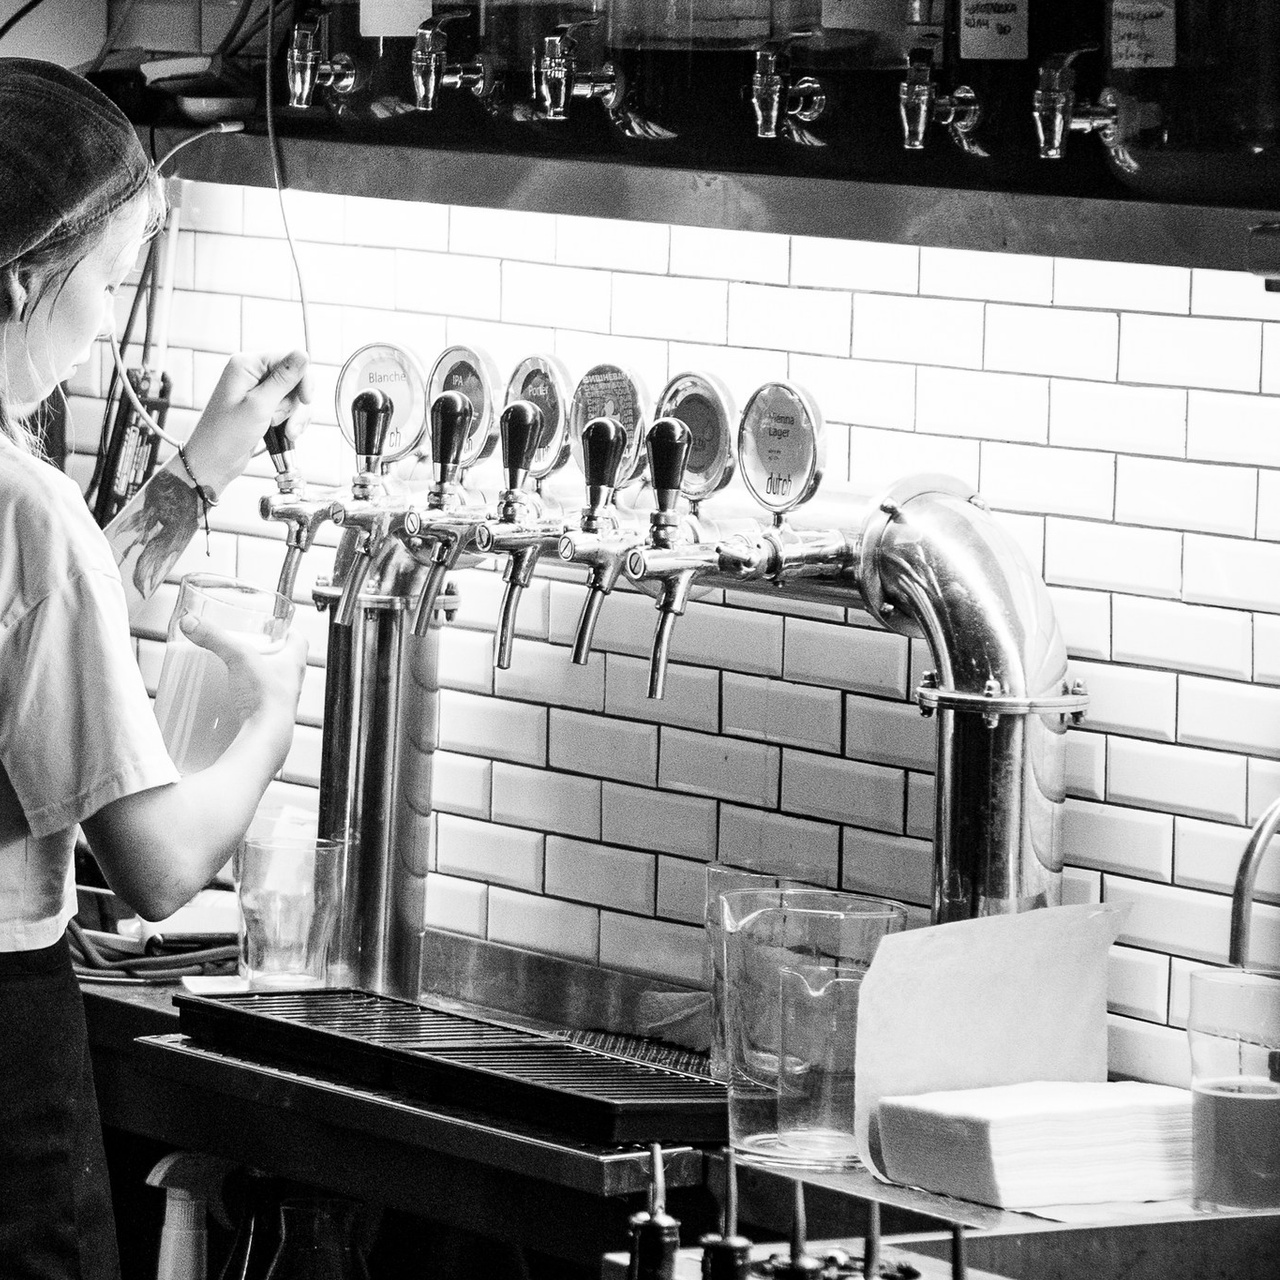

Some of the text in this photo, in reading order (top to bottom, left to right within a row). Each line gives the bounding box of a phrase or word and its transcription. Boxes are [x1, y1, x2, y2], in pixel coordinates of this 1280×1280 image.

[368, 371, 407, 383] Blanche
[452, 374, 464, 386] IPA
[768, 427, 791, 440] Lager
[765, 471, 793, 496] dutch
